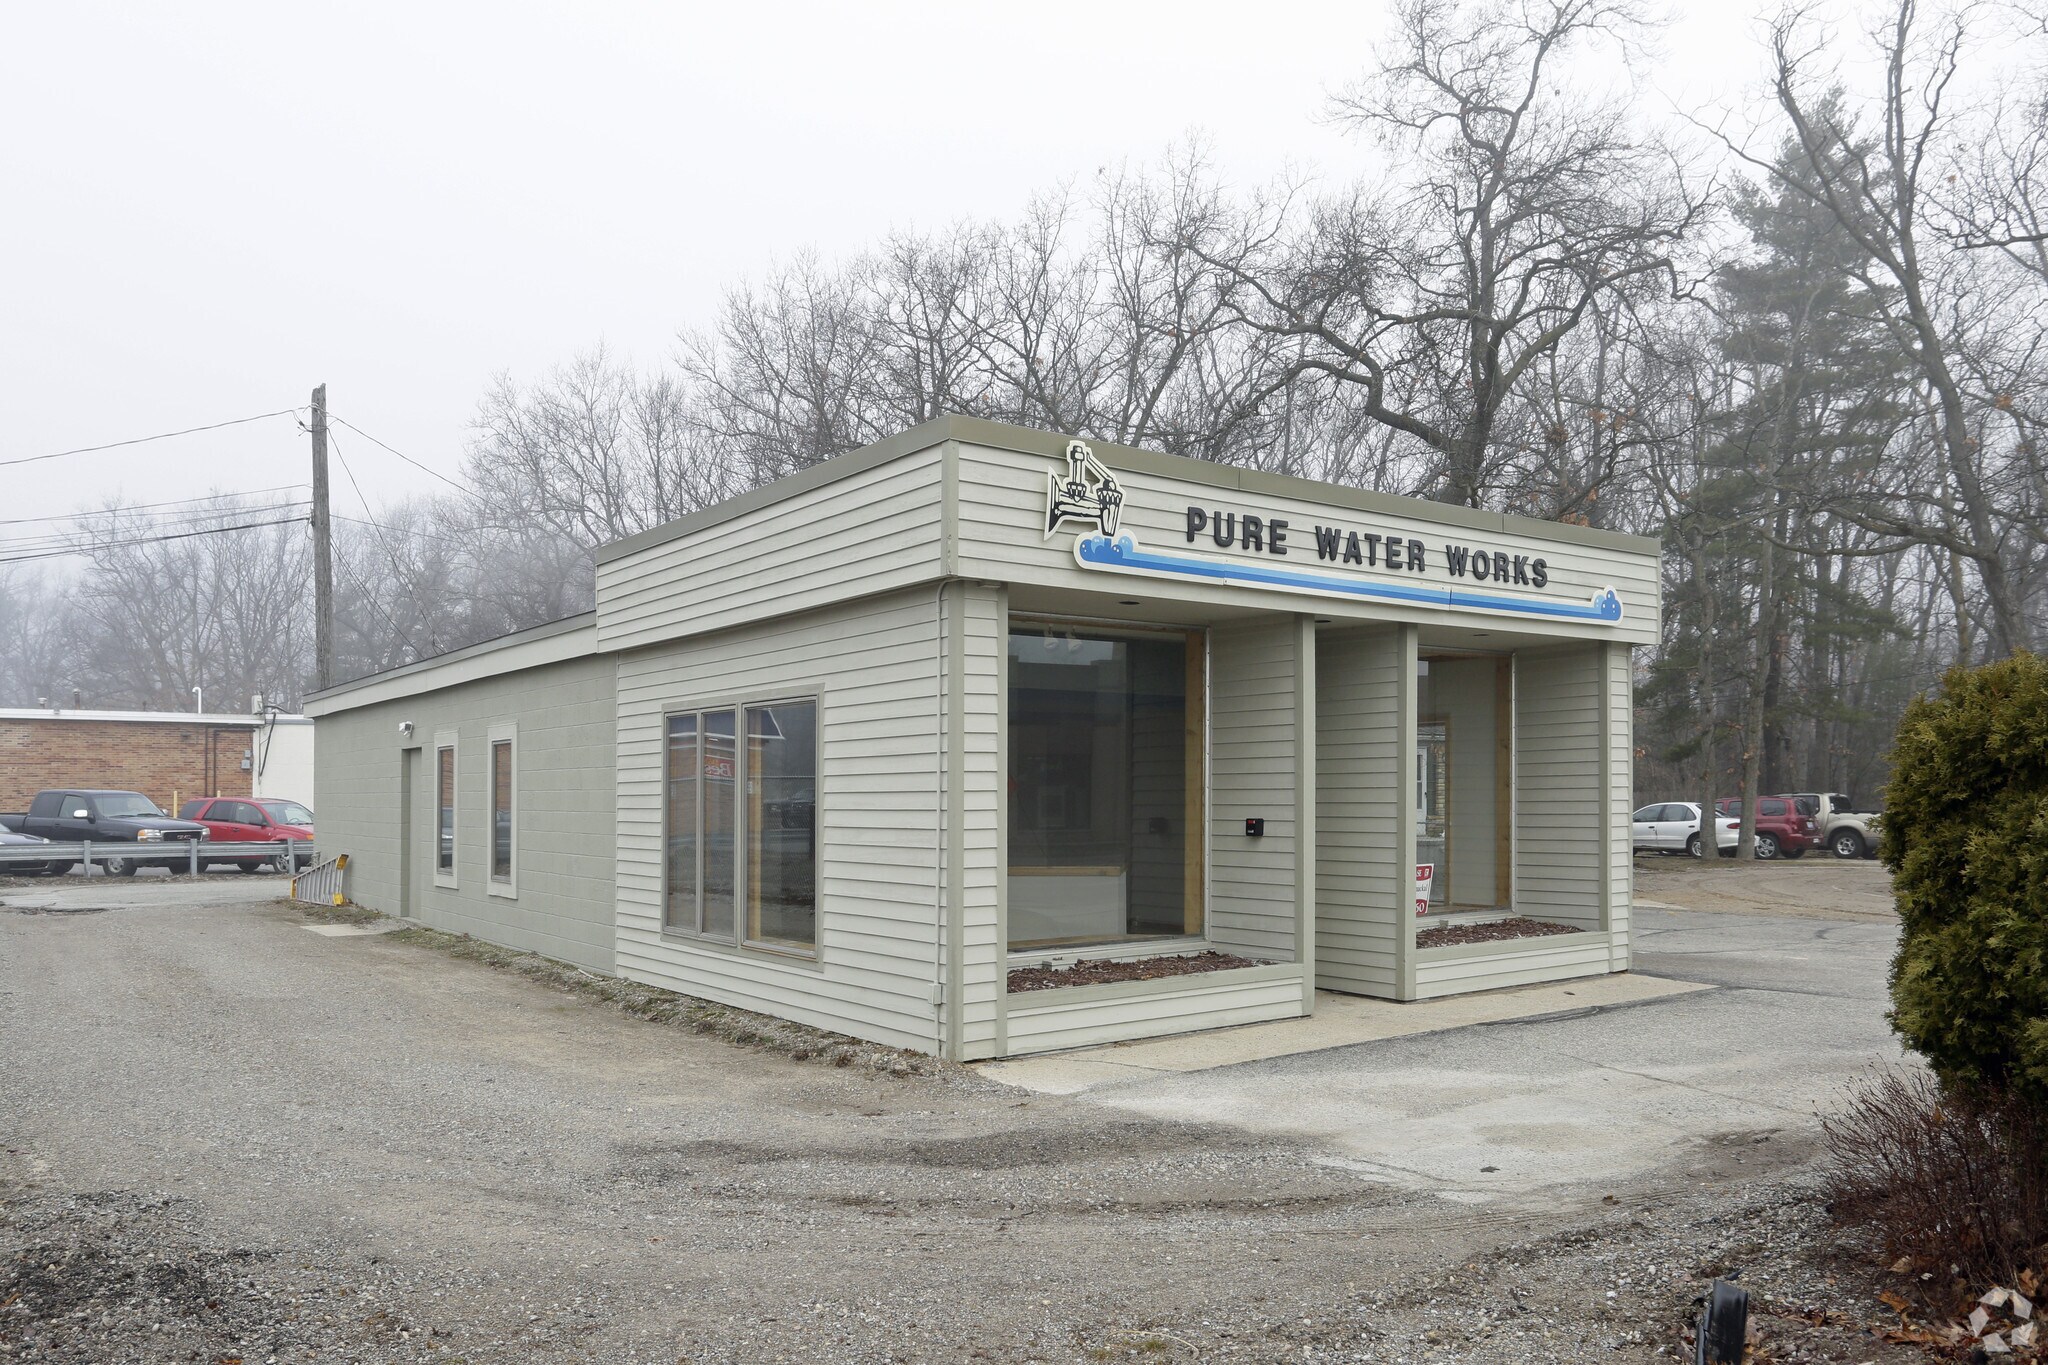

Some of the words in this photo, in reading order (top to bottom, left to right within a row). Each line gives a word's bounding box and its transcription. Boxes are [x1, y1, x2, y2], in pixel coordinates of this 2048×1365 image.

[1187, 506, 1288, 555] PURE
[1315, 525, 1426, 572] WATER
[1446, 544, 1548, 588] WORKS
